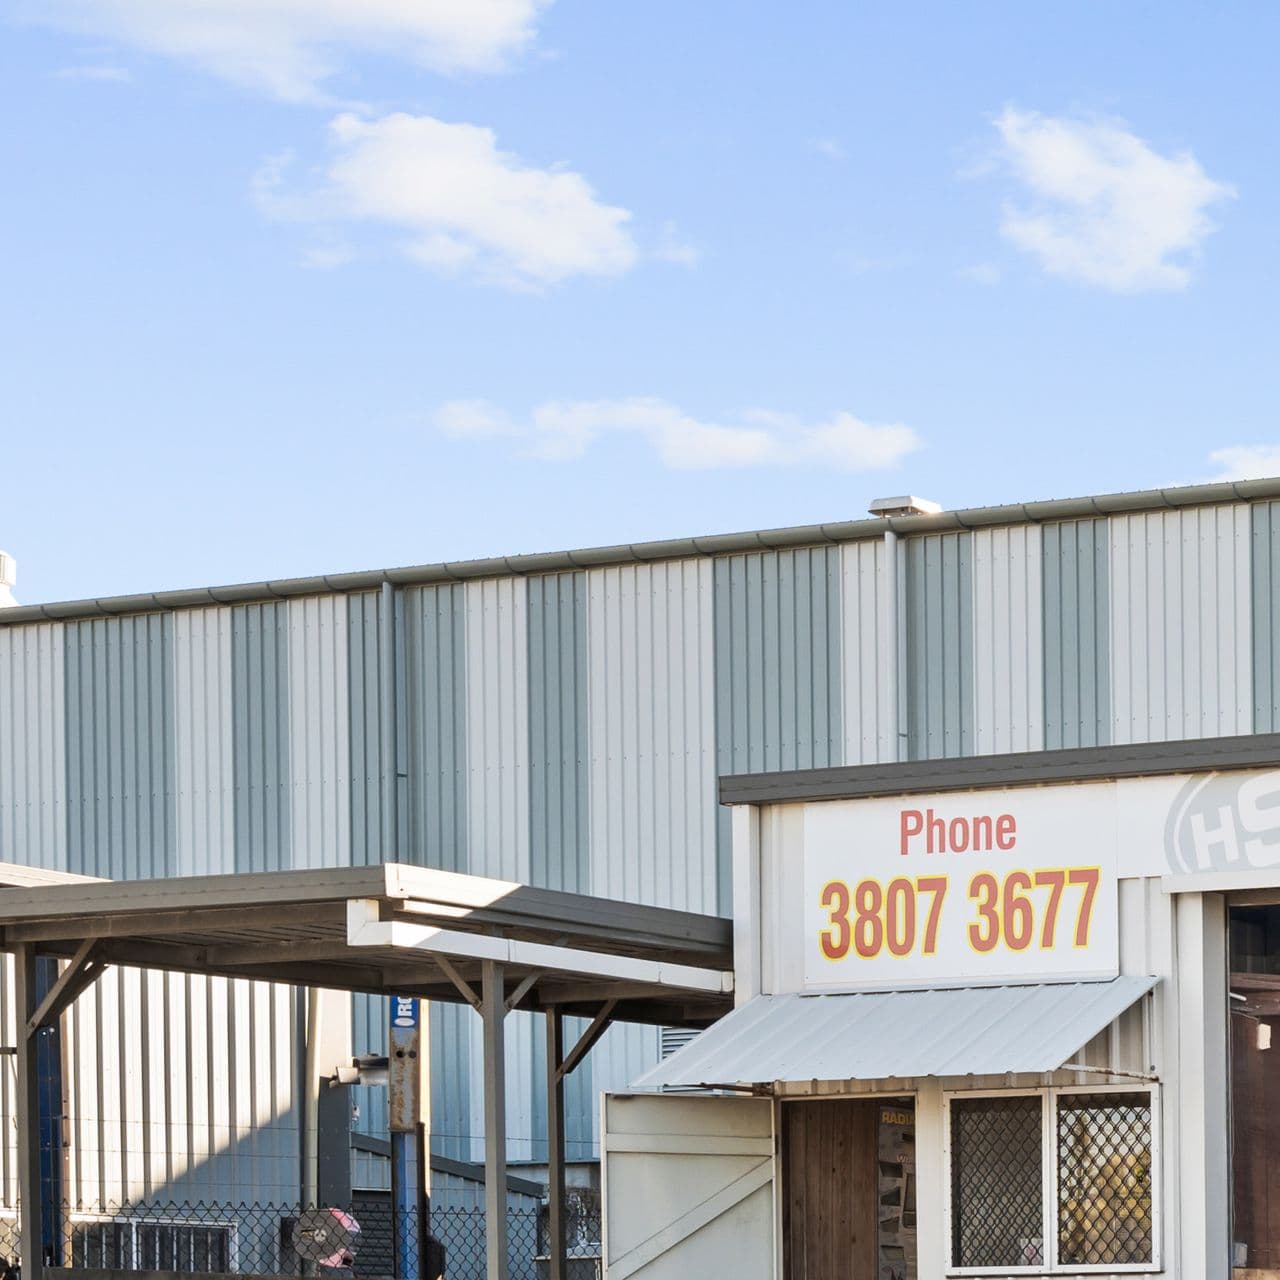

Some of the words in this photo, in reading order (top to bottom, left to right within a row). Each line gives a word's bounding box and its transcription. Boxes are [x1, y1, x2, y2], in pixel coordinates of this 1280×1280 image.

[900, 809, 1017, 856] Phone
[819, 875, 948, 962] 3807
[966, 865, 1101, 954] 3677
